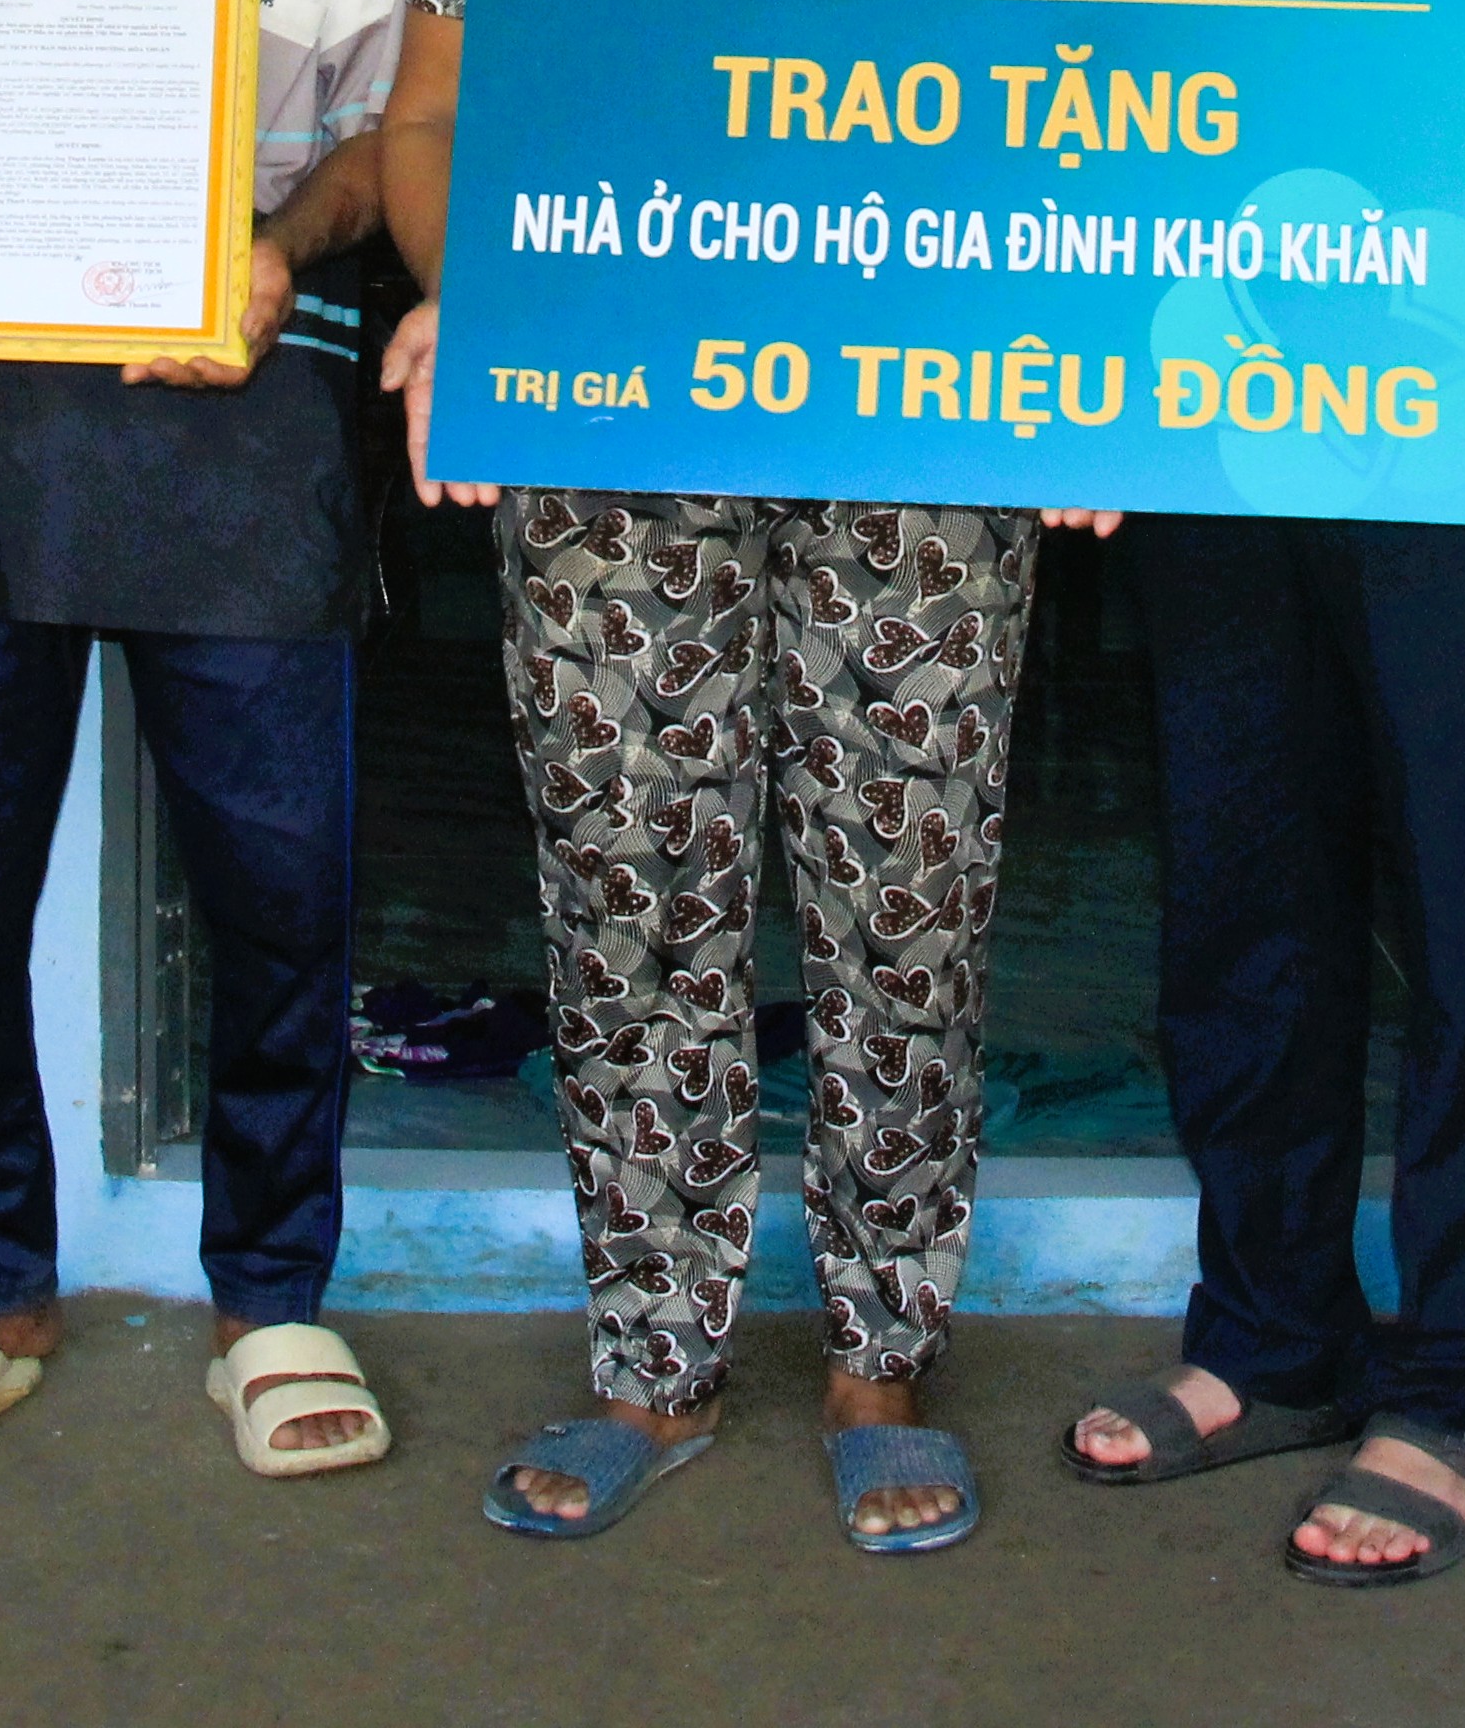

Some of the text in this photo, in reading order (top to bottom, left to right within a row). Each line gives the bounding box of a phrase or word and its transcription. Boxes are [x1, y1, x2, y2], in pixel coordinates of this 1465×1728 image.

[714, 43, 1239, 169] TRAO TẶNG
[512, 179, 1429, 286] NHÀ Ở CHO HỘ GIA ĐÌNH KHÓ KHĂN
[489, 333, 1440, 439] TRỊ GIÁ 50 TRIỆU ĐỒNG
